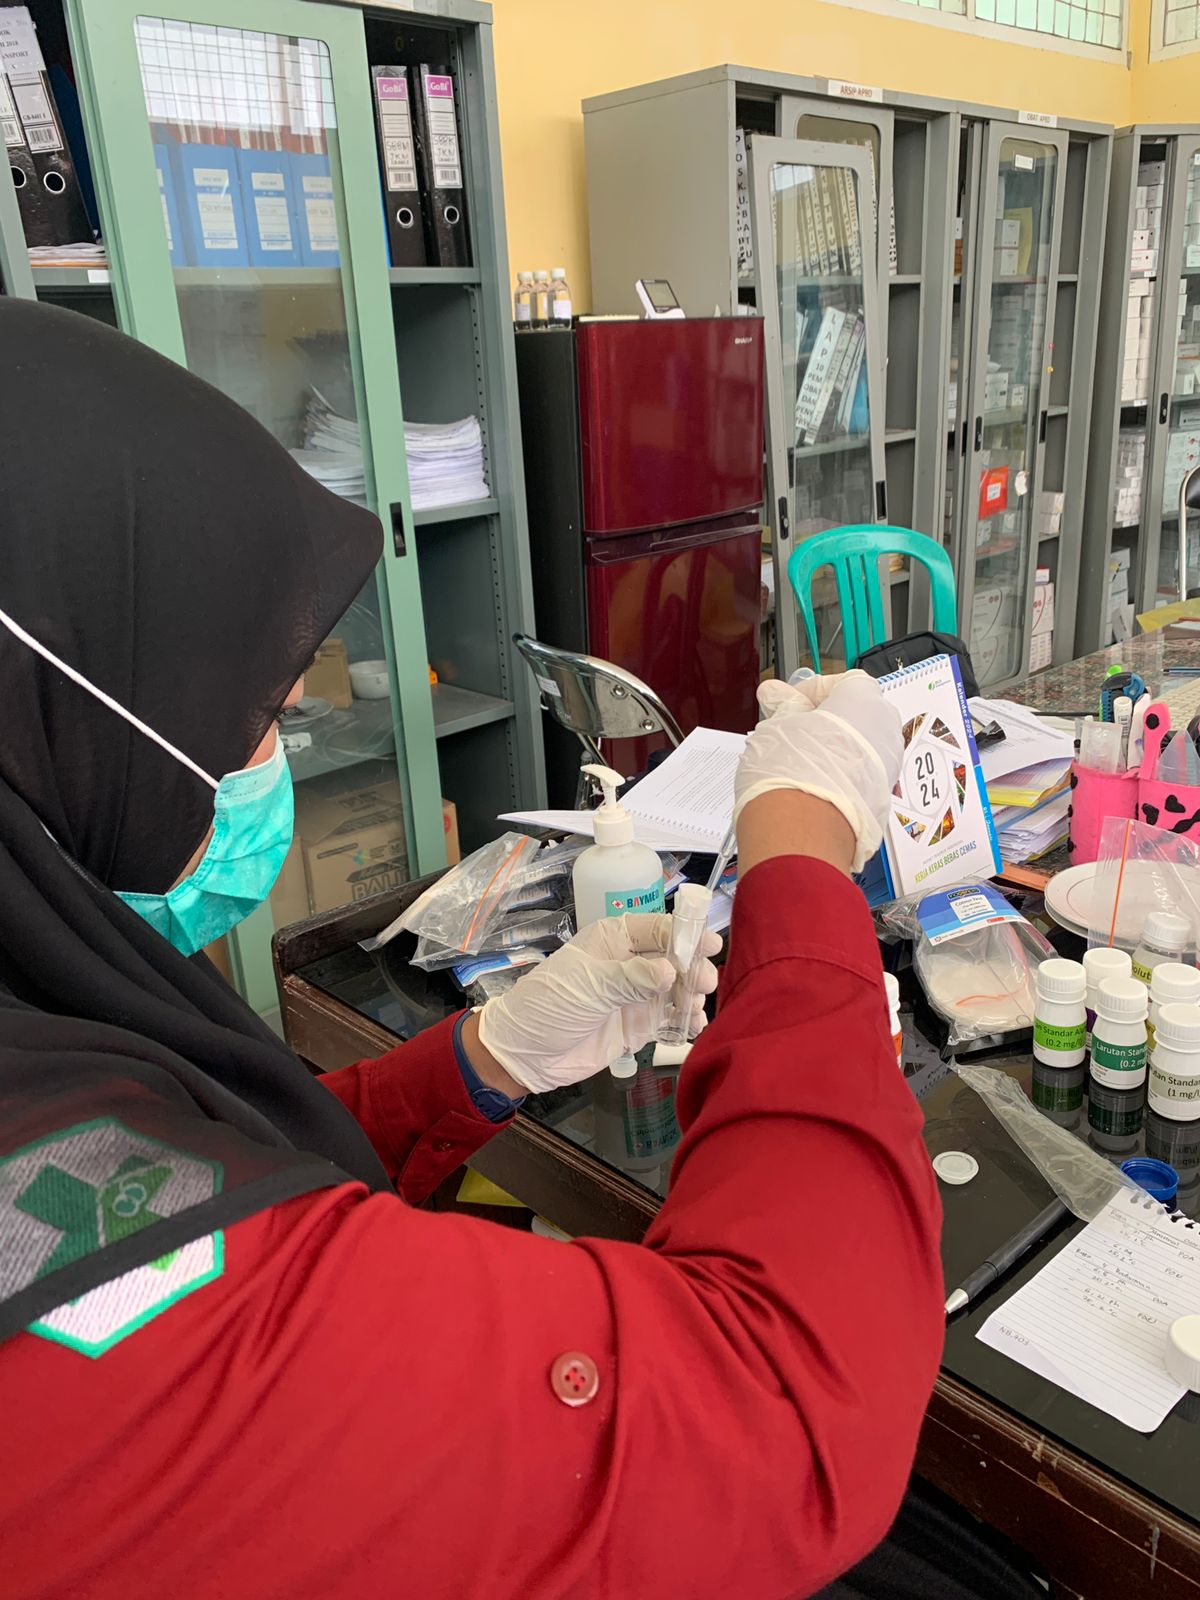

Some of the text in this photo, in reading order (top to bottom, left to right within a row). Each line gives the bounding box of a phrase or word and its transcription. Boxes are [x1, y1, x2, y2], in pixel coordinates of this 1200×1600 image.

[840, 85, 857, 96] ARSIP
[915, 752, 934, 780] 20
[920, 778, 940, 807] 24
[959, 840, 977, 857] CEMAS
[1132, 964, 1151, 978] olut
[1043, 1026, 1073, 1037] Standar
[1046, 1038, 1061, 1048] (0.2
[1096, 1041, 1126, 1057] Larutan
[1120, 1059, 1136, 1068] (0.2
[1167, 1087, 1176, 1098] (1
